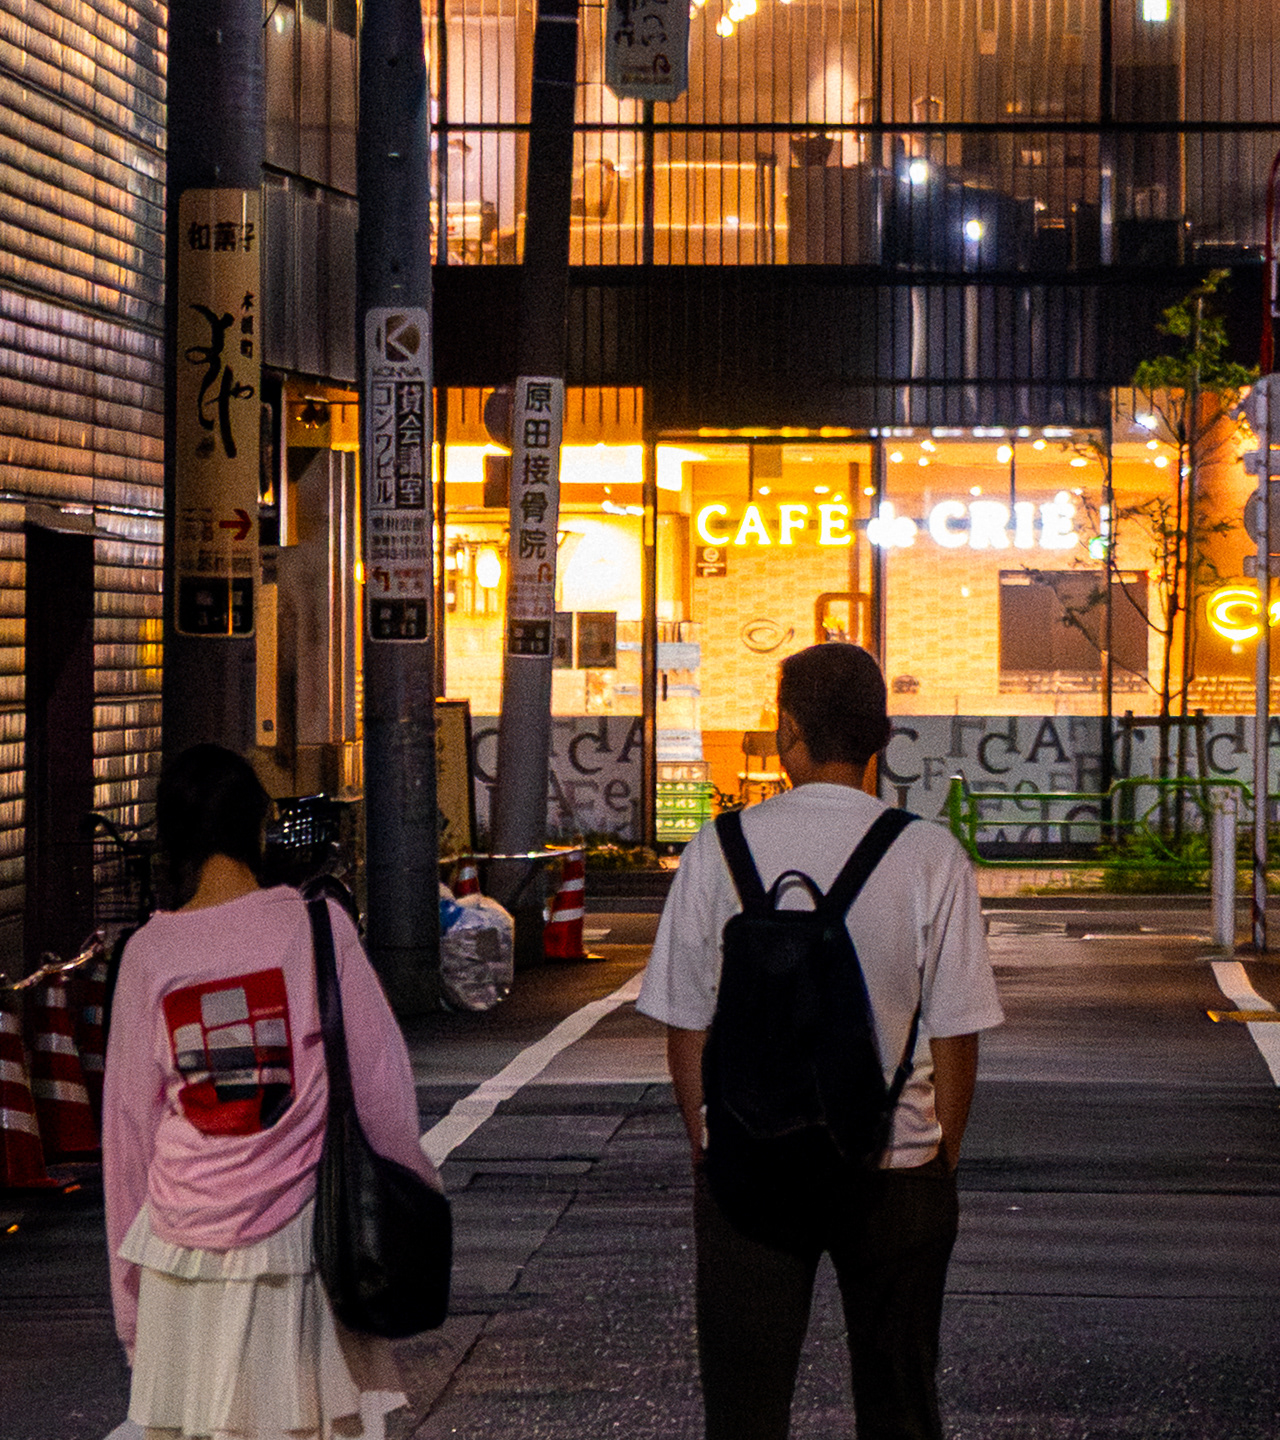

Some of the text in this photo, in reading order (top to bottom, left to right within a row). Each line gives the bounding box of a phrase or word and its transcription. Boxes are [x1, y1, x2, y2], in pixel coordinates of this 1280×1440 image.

[188, 222, 255, 252] 和菓子
[374, 384, 394, 506] コンワビル
[519, 381, 553, 560] 原田接骨院
[697, 493, 853, 547] CAFÉ
[929, 490, 1081, 550] CRIÉ
